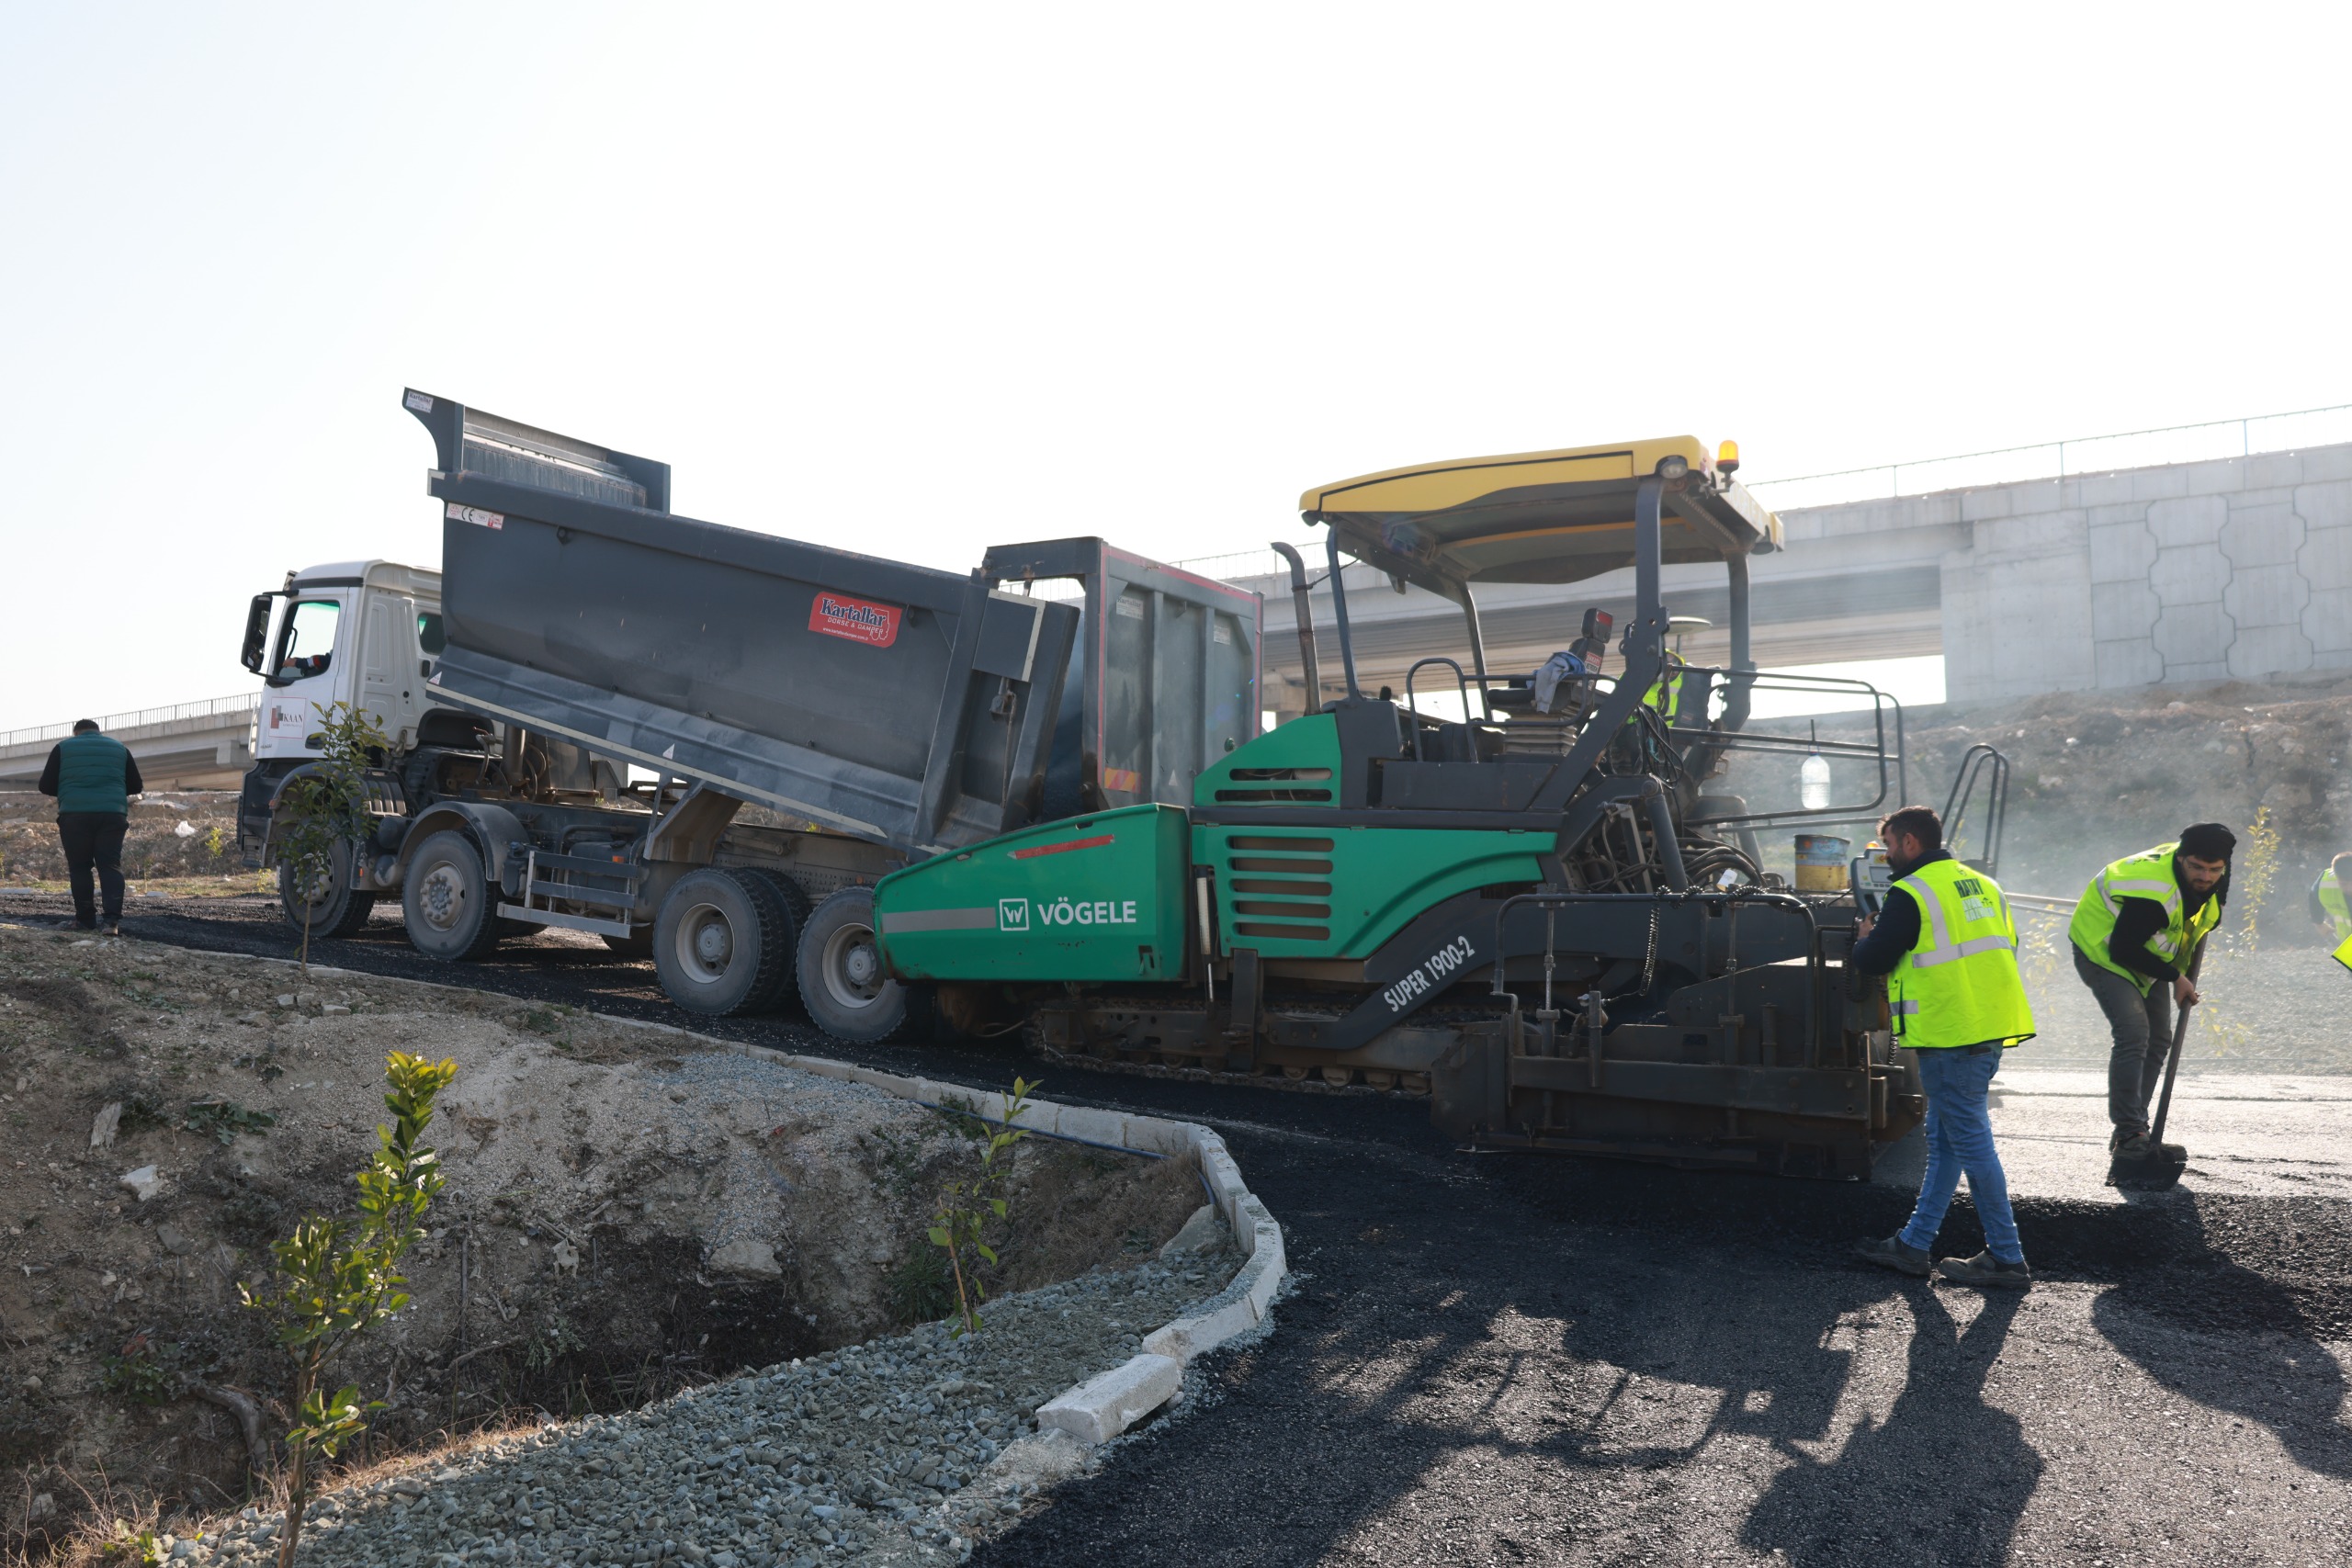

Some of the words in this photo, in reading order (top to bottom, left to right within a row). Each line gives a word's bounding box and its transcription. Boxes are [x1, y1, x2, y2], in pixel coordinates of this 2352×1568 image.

[820, 598, 887, 627] Kartallar
[828, 616, 850, 626] DORSE
[857, 624, 884, 635] DAMPER
[284, 713, 303, 723] KAAN
[1953, 878, 1984, 898] HATAY
[1037, 897, 1136, 925] VÖGELE
[1384, 970, 1430, 1012] SUPER
[1424, 935, 1476, 981] 1900-2
